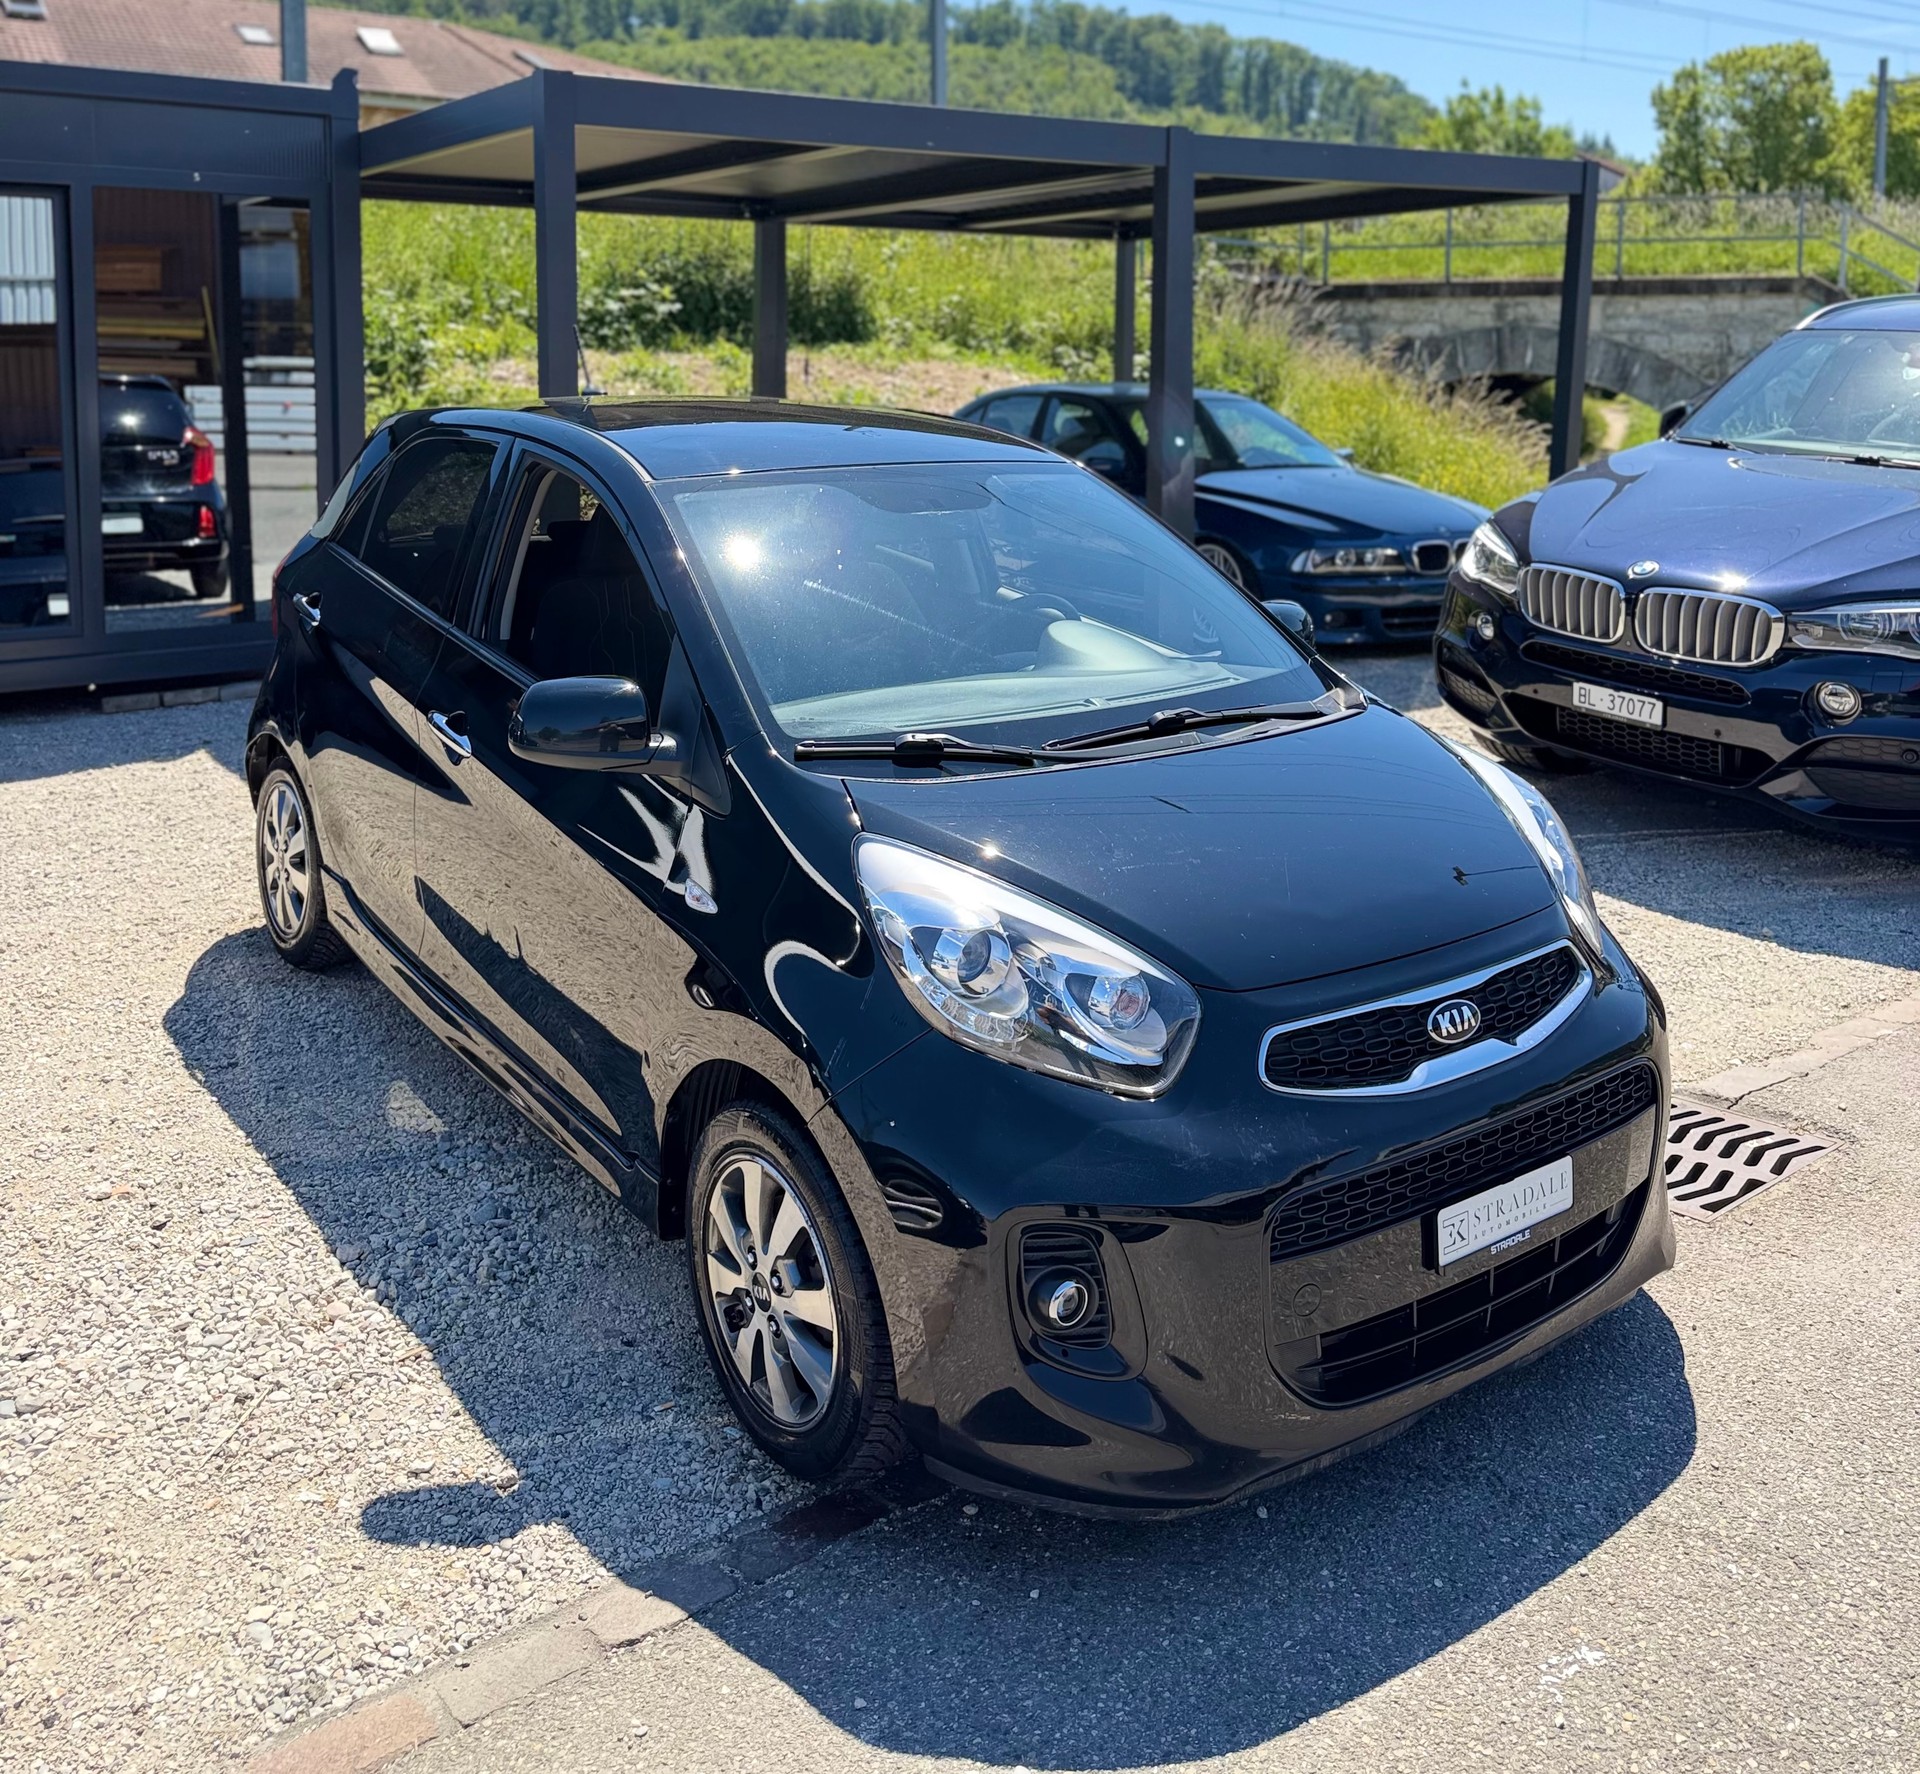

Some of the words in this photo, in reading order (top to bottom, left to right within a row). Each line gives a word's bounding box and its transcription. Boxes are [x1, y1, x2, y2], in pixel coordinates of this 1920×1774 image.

[1578, 686, 1596, 707] BL
[1607, 693, 1656, 720] 37077
[1436, 1005, 1476, 1037] KIA
[1473, 1170, 1569, 1228] STRADALE
[1473, 1203, 1548, 1241] AUTOMOBILE
[1490, 1229, 1531, 1255] STRADALE
[753, 1285, 771, 1302] KIA
